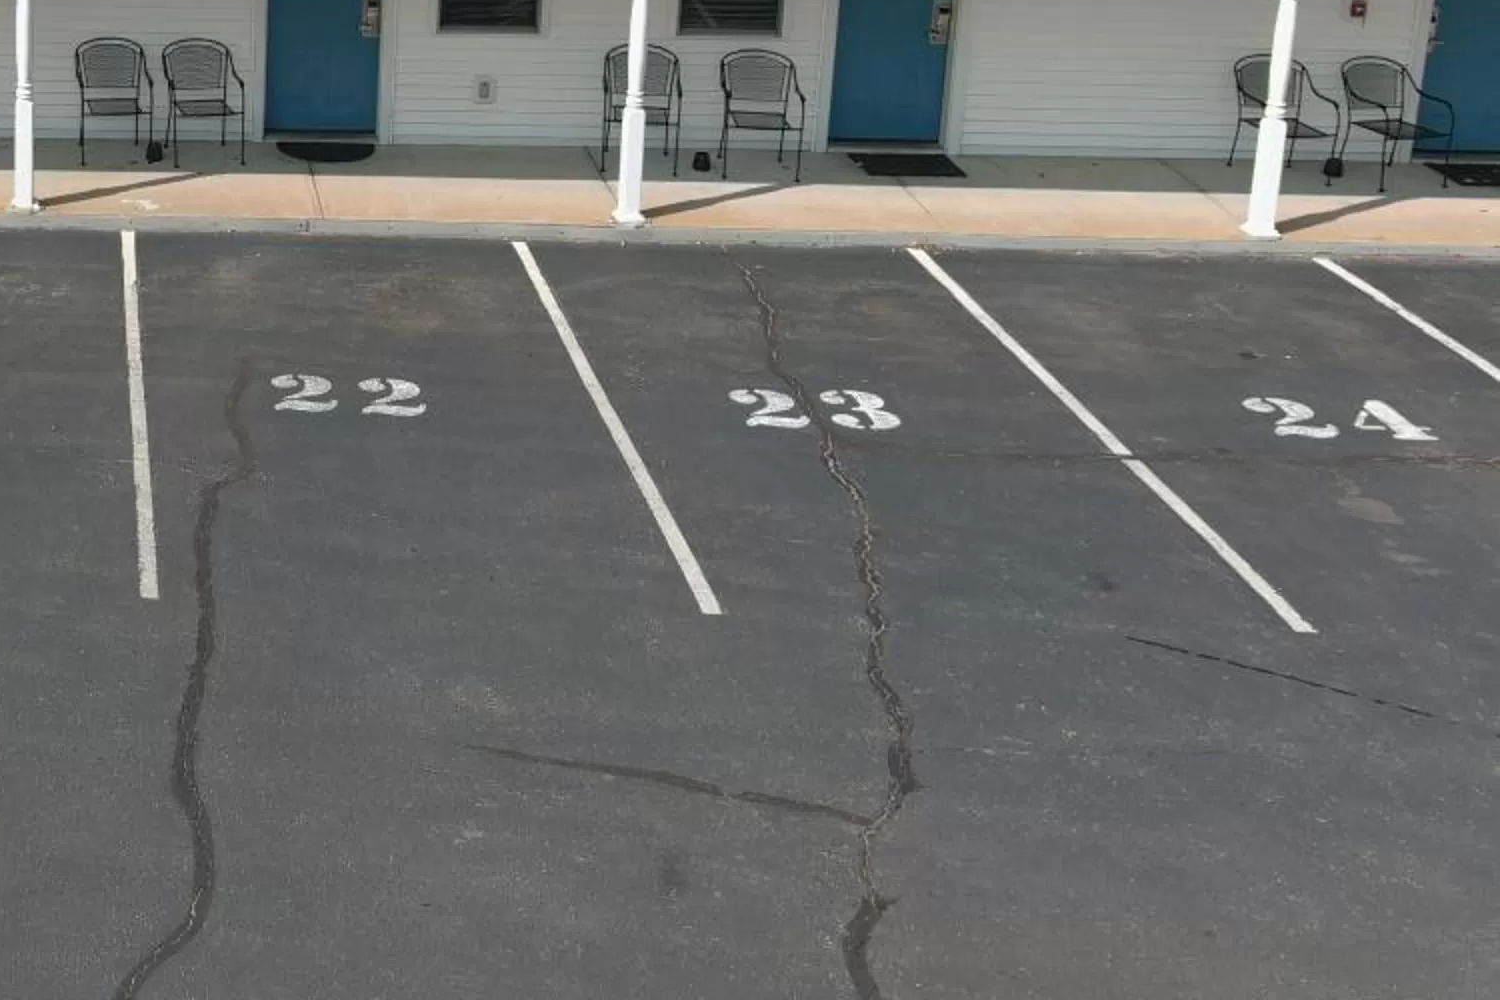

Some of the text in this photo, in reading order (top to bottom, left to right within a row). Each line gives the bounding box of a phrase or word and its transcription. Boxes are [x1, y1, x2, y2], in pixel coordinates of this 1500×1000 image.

[271, 374, 427, 417] 22
[728, 388, 902, 431] 23
[1241, 397, 1440, 441] 24
